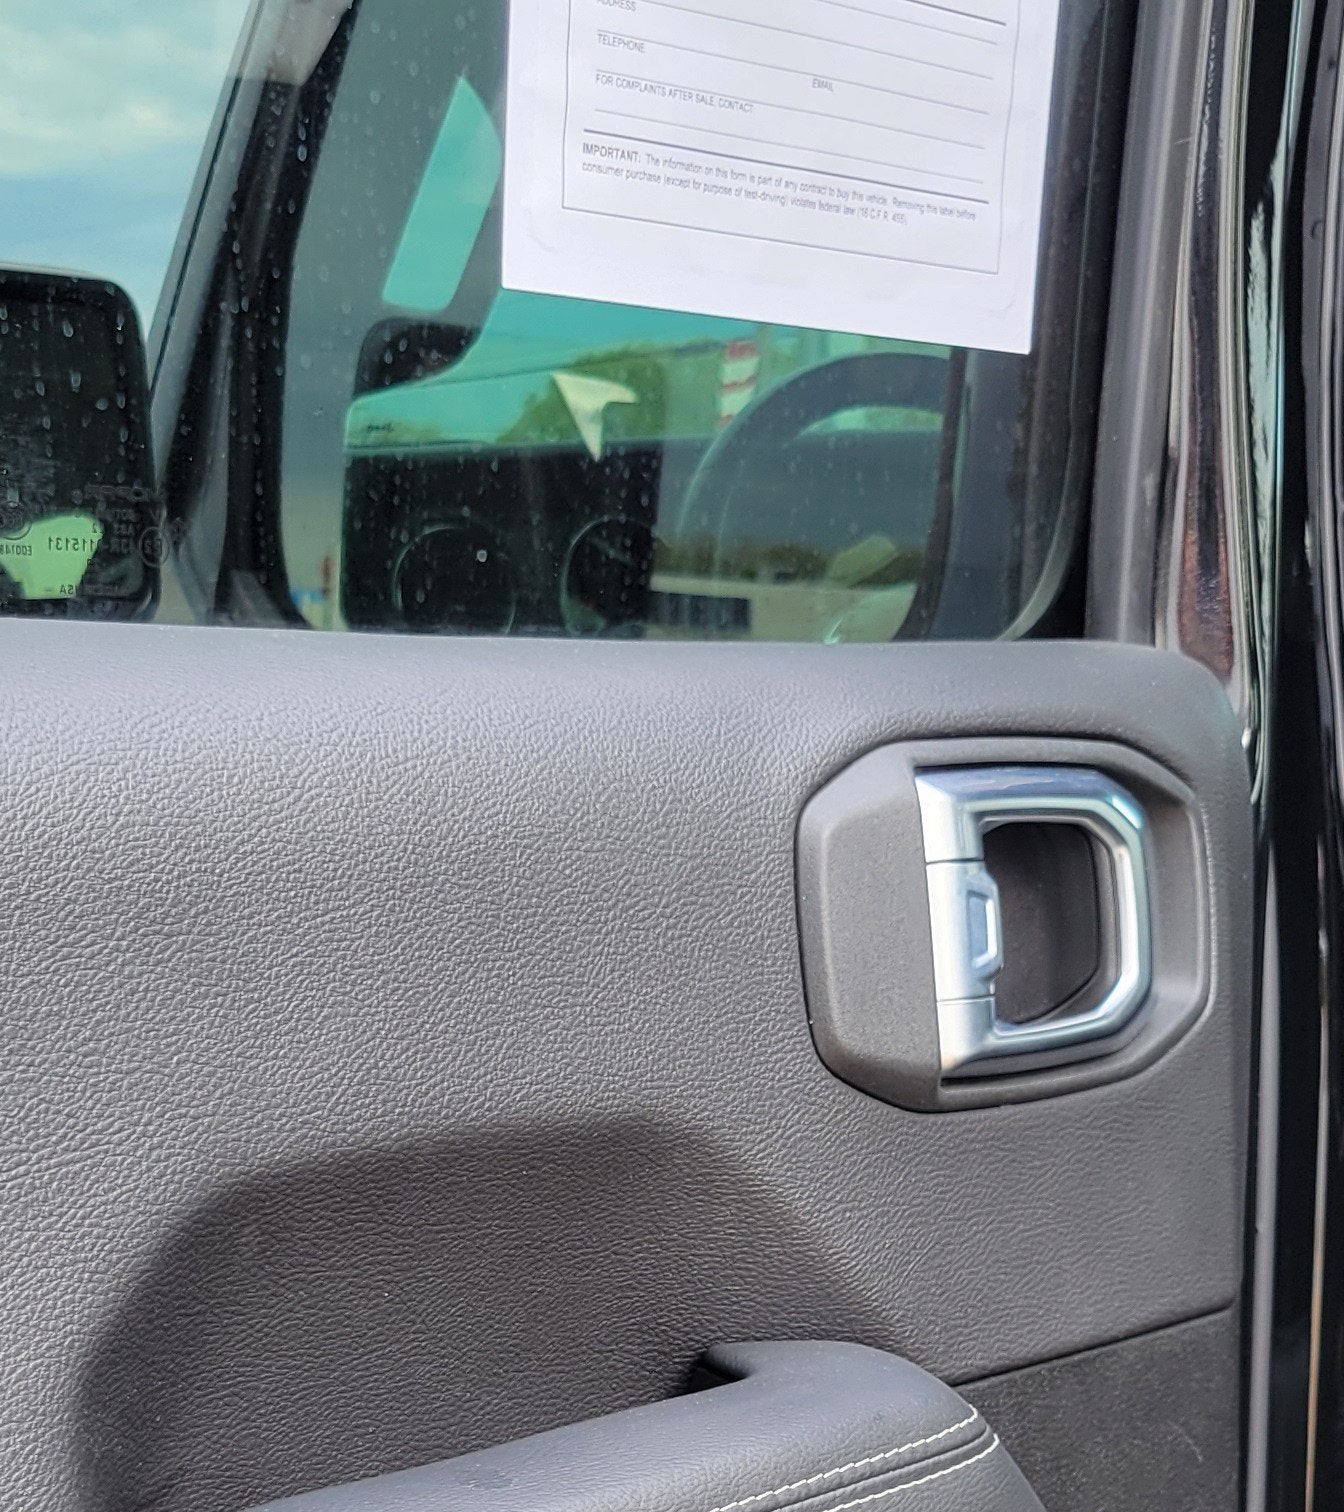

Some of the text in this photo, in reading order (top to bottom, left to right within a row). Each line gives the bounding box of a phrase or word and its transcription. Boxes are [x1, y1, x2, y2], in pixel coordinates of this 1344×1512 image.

[597, 33, 646, 53] TELEPHONE
[595, 73, 614, 86] FOR
[615, 77, 667, 97] COMPLAINTS
[668, 88, 693, 102] AFTER
[582, 142, 641, 164] IMPORTANT:
[645, 153, 660, 167] The
[582, 162, 624, 177] consumer
[625, 168, 661, 184] purchase
